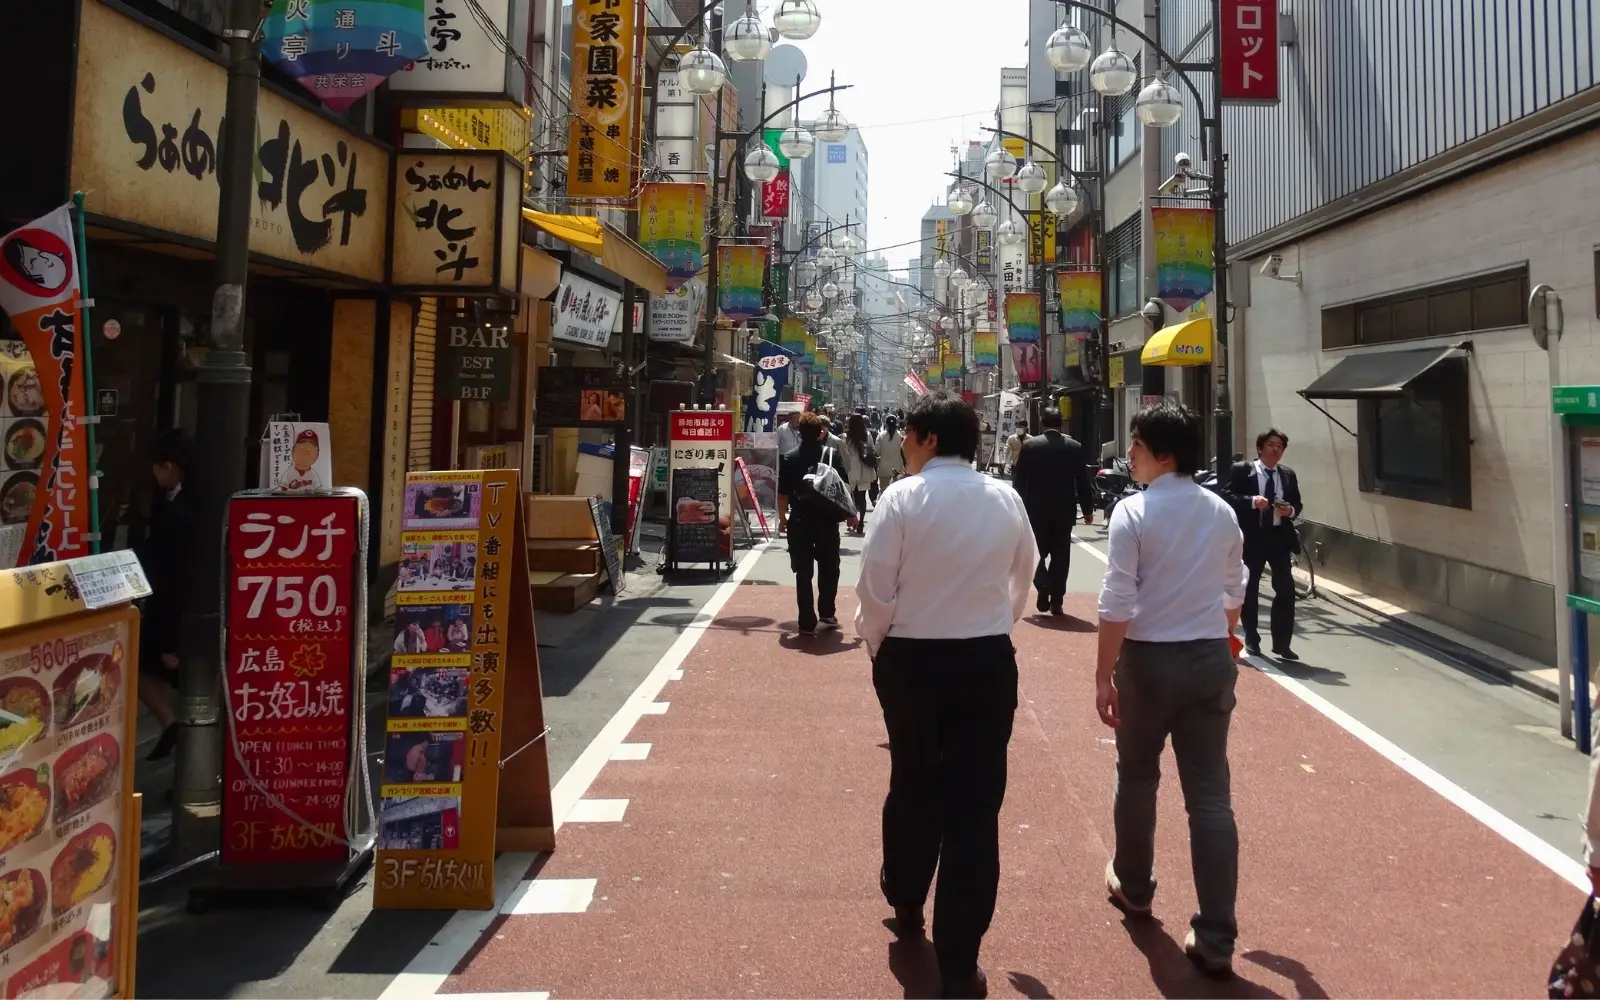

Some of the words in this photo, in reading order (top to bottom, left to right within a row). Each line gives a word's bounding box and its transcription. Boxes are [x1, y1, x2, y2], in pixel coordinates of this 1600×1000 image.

[1236, 3, 1264, 89] ロット
[315, 73, 366, 89] 共栄会
[123, 72, 228, 181] らぁめ
[405, 160, 492, 192] らぁめん
[764, 181, 775, 214] ーメン
[448, 326, 509, 349] BAR
[461, 356, 494, 369] EST
[461, 386, 492, 399] B1F
[674, 449, 728, 460] にぎり寿司
[239, 511, 347, 562] ランチ
[469, 481, 508, 767] TV番組にも出演多数!!
[29, 637, 81, 675] 560円
[235, 646, 286, 674] 広島
[233, 679, 345, 722] お好み焼
[381, 857, 418, 890] 3F
